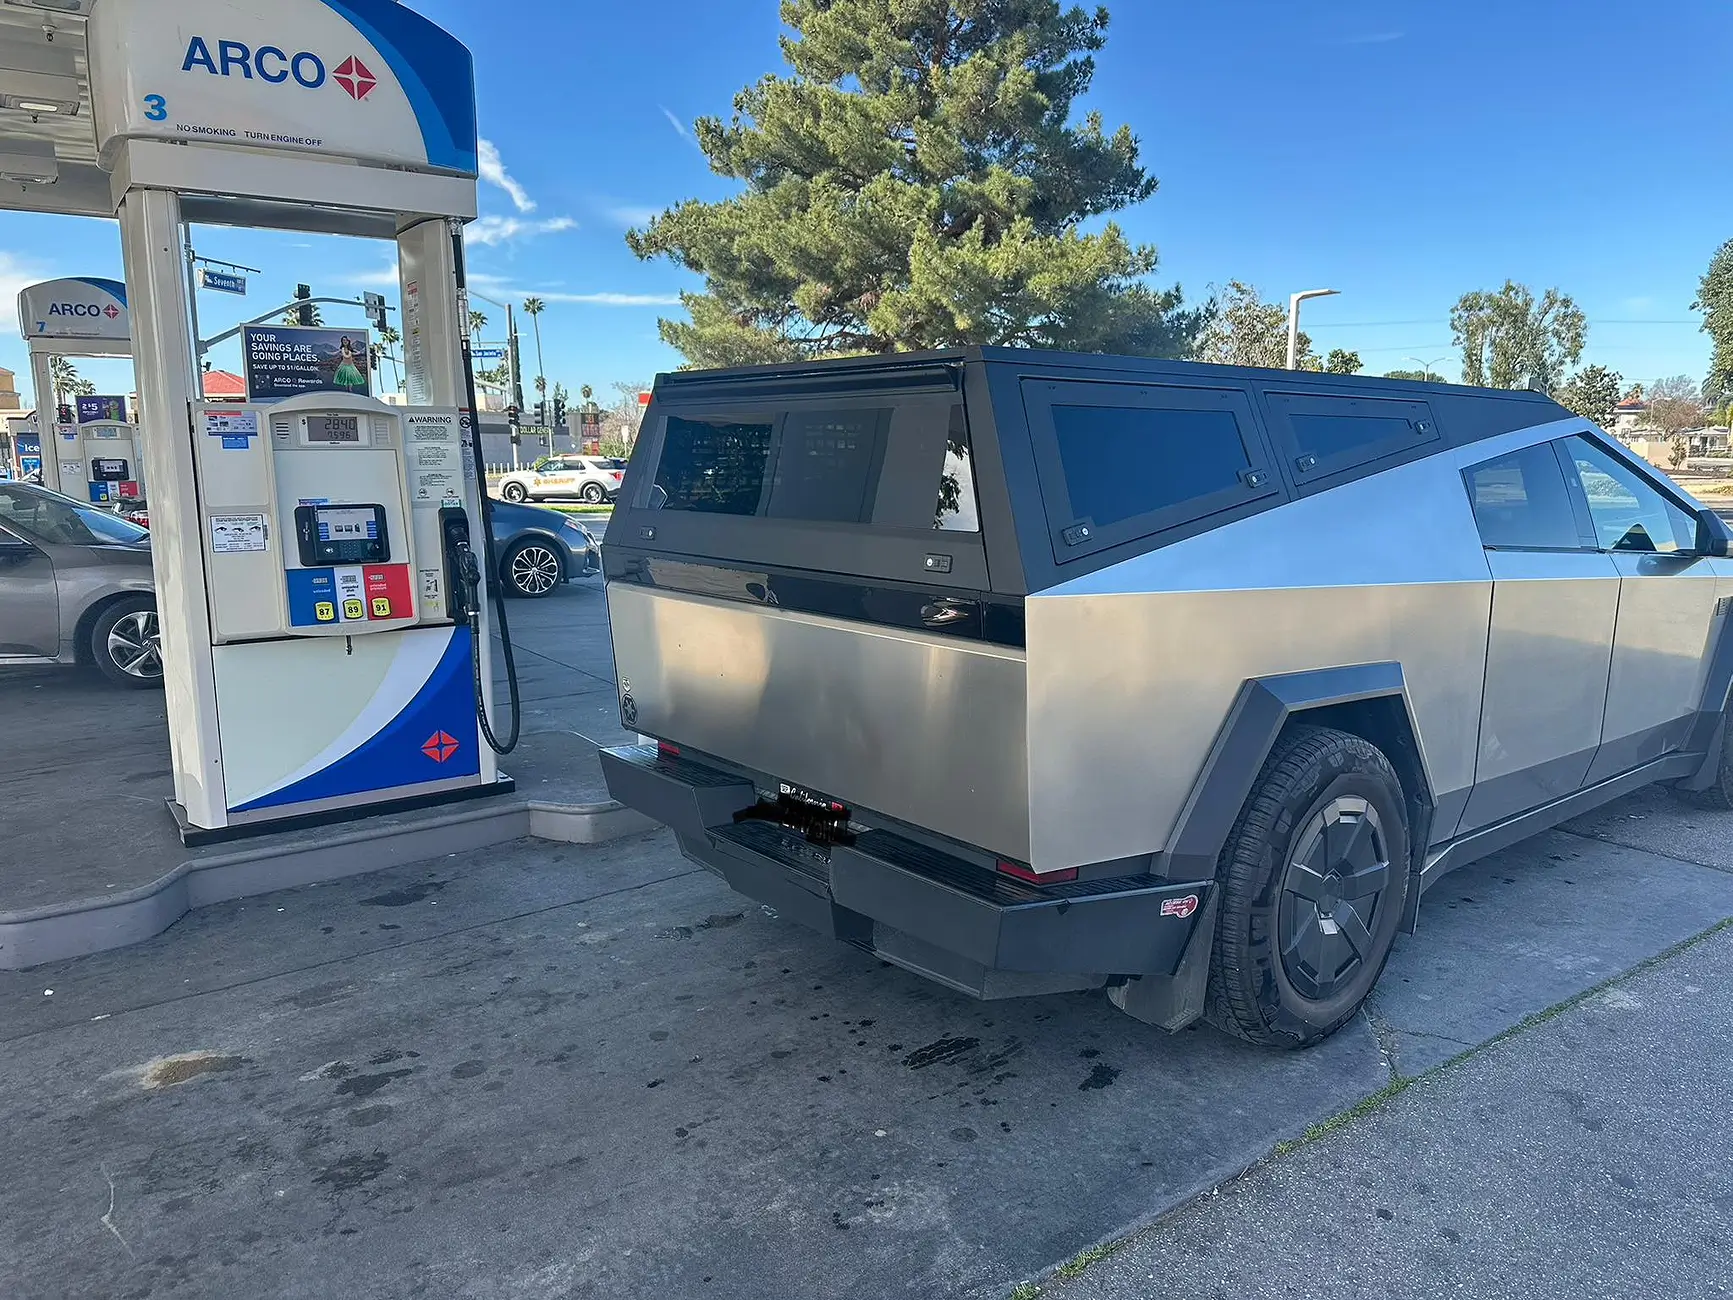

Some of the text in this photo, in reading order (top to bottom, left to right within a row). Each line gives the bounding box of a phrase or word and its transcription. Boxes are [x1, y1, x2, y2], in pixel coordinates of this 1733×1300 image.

[181, 36, 326, 89] ARCO
[143, 93, 168, 121] 3
[176, 123, 323, 147] NO SMOKING TURN ENGINE OFF
[48, 302, 101, 317] ARCO
[35, 321, 46, 333] 7
[250, 333, 276, 342] YOUR
[251, 342, 312, 353] SAVINGS ARE
[252, 352, 320, 363] GOING PLACES.
[413, 416, 452, 424] WARNING
[520, 426, 537, 434] DOLLAR
[24, 443, 40, 452] Ice
[318, 608, 330, 616] 87
[347, 605, 359, 614] 89
[375, 604, 387, 612] 91
